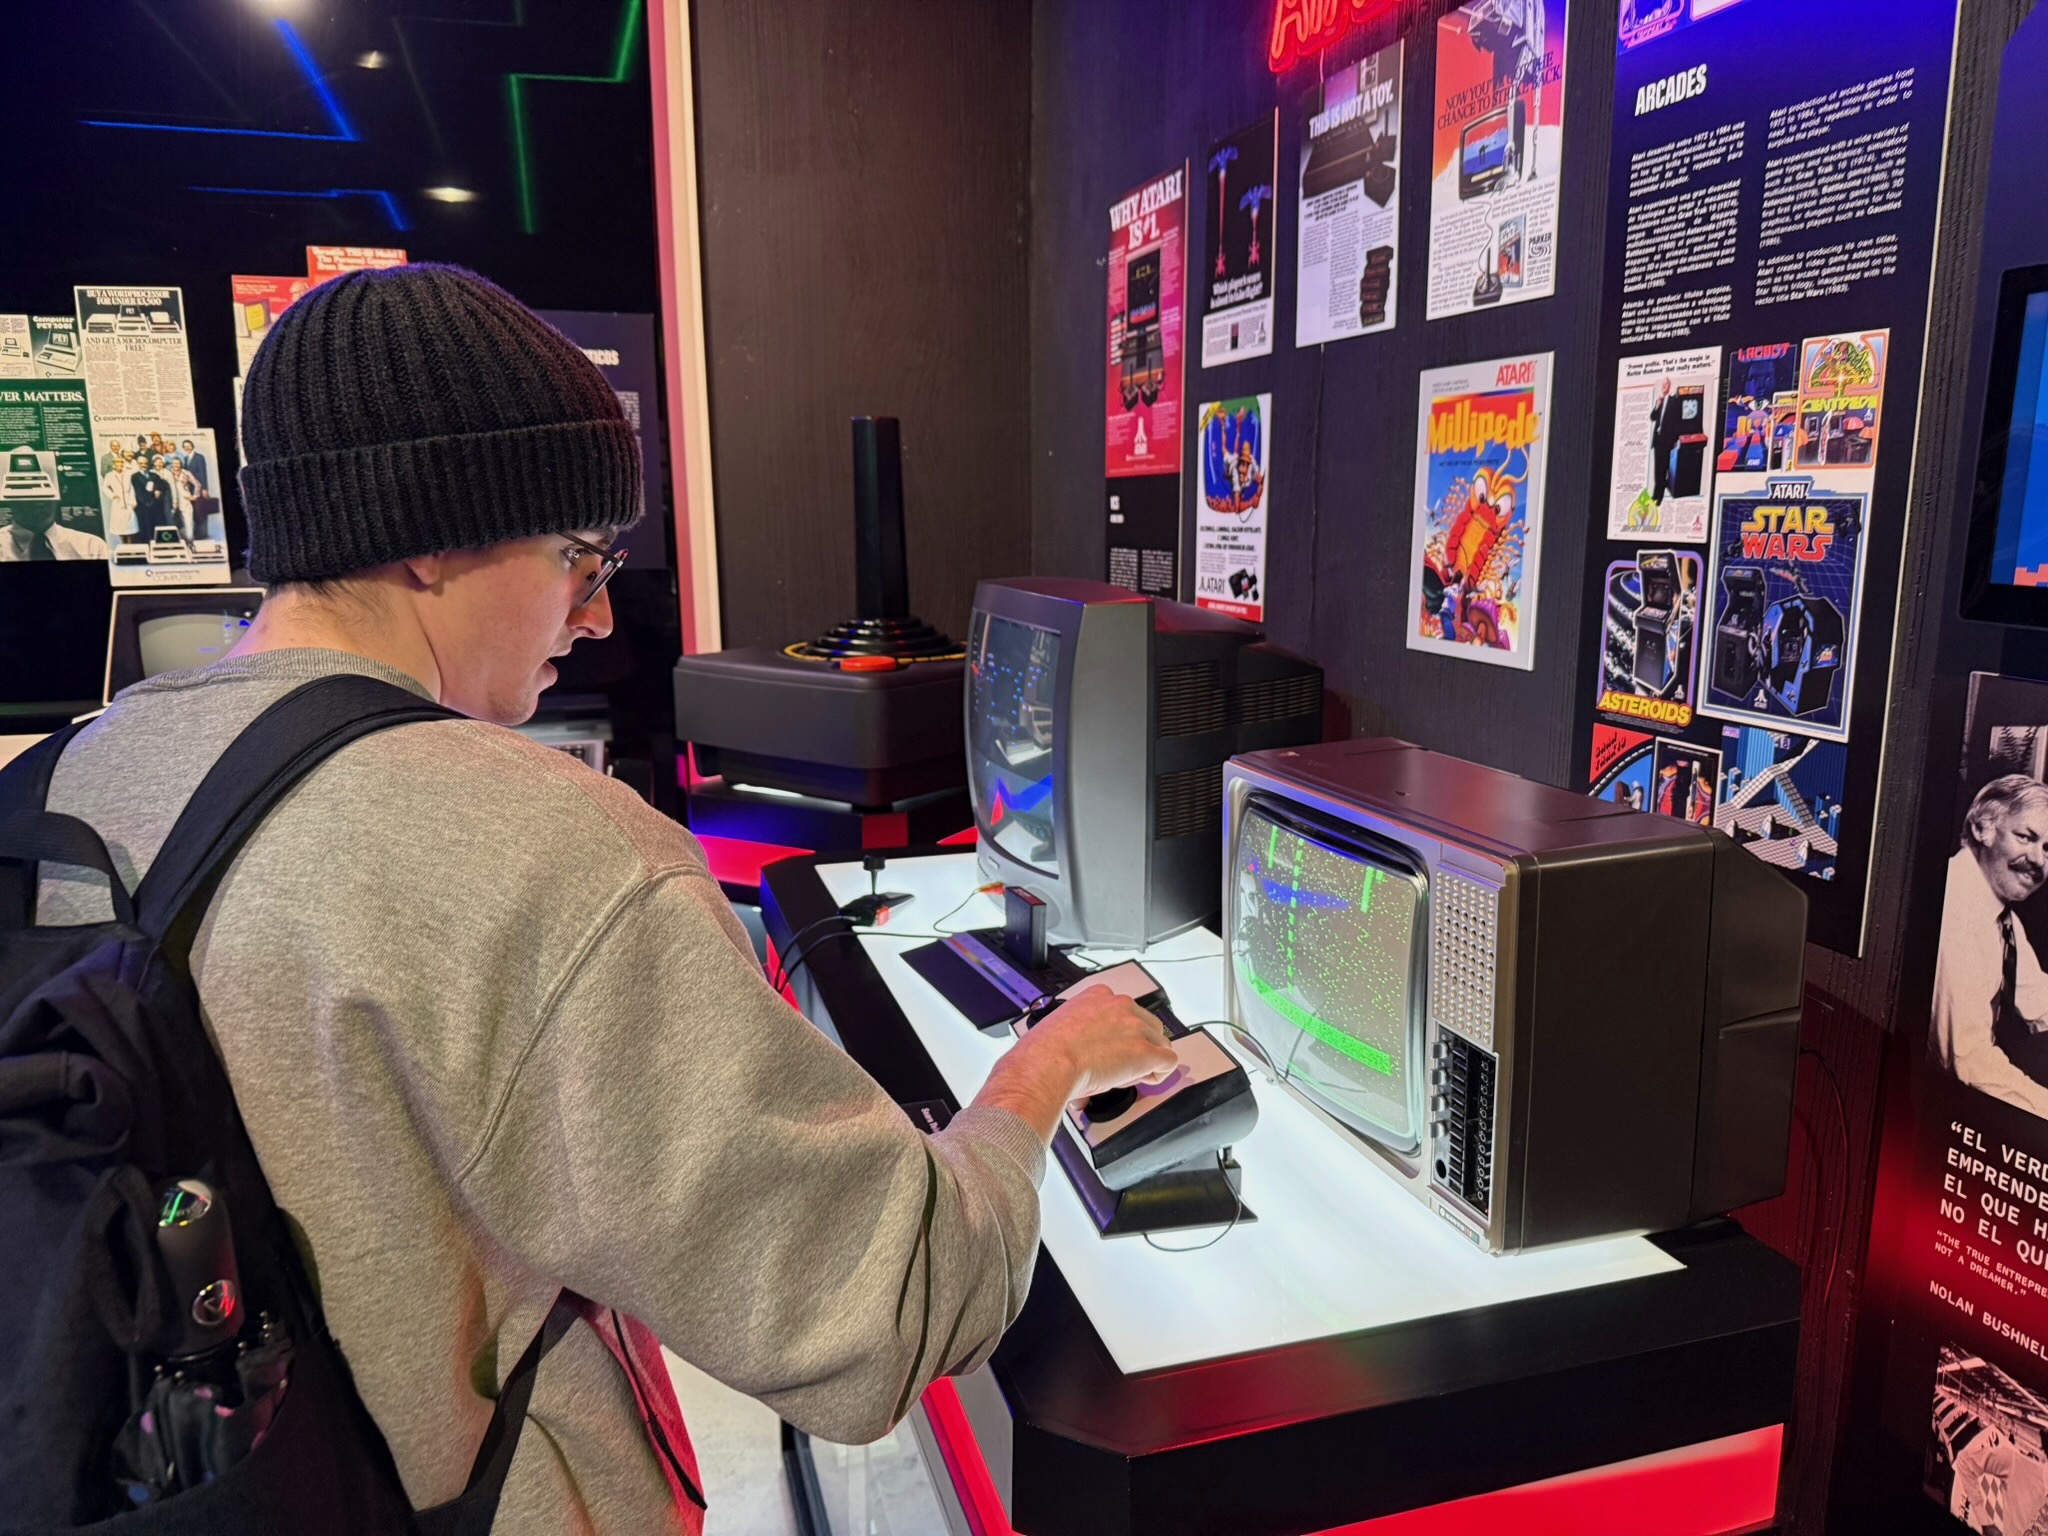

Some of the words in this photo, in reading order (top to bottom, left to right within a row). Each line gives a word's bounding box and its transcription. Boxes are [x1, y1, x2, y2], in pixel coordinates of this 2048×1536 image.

[1445, 88, 1470, 111] NOW
[1634, 63, 1707, 117] ARCADES
[1309, 110, 1330, 139] THIS
[1330, 104, 1341, 130] IS
[1340, 93, 1363, 125] NOT
[1362, 89, 1372, 116] A
[1371, 78, 1394, 108] TOY.
[1437, 101, 1476, 130] CHANCE
[1476, 95, 1491, 111] TO
[1109, 191, 1140, 233] WHY
[1139, 169, 1183, 218] ATARI
[1128, 219, 1143, 250] IS
[1529, 232, 1552, 246] PARKER
[33, 316, 75, 325] Computer
[1495, 361, 1535, 387] ATARI
[1687, 355, 1703, 364] magic
[23, 391, 85, 402] MATTERS.
[1424, 398, 1541, 458] Millipede
[1772, 484, 1805, 499] ATARI
[1741, 506, 1835, 533] STAR
[1741, 533, 1834, 562] WARS
[1597, 690, 1692, 727] ASTEROIDS
[1947, 1147, 2048, 1213] EMPRENDE
[1944, 1173, 1968, 1200] EL
[1981, 1192, 2021, 1226] QUE
[1940, 1198, 1965, 1224] NO
[1978, 1218, 2002, 1246] EL
[2016, 1239, 2048, 1272] QU
[1935, 1242, 1953, 1257] NOT
[1958, 1255, 1965, 1265] A
[1966, 1245, 1990, 1266] TRUE
[1929, 1280, 1974, 1316] NOLAN
[1982, 1311, 2048, 1361] BUSHNEL
